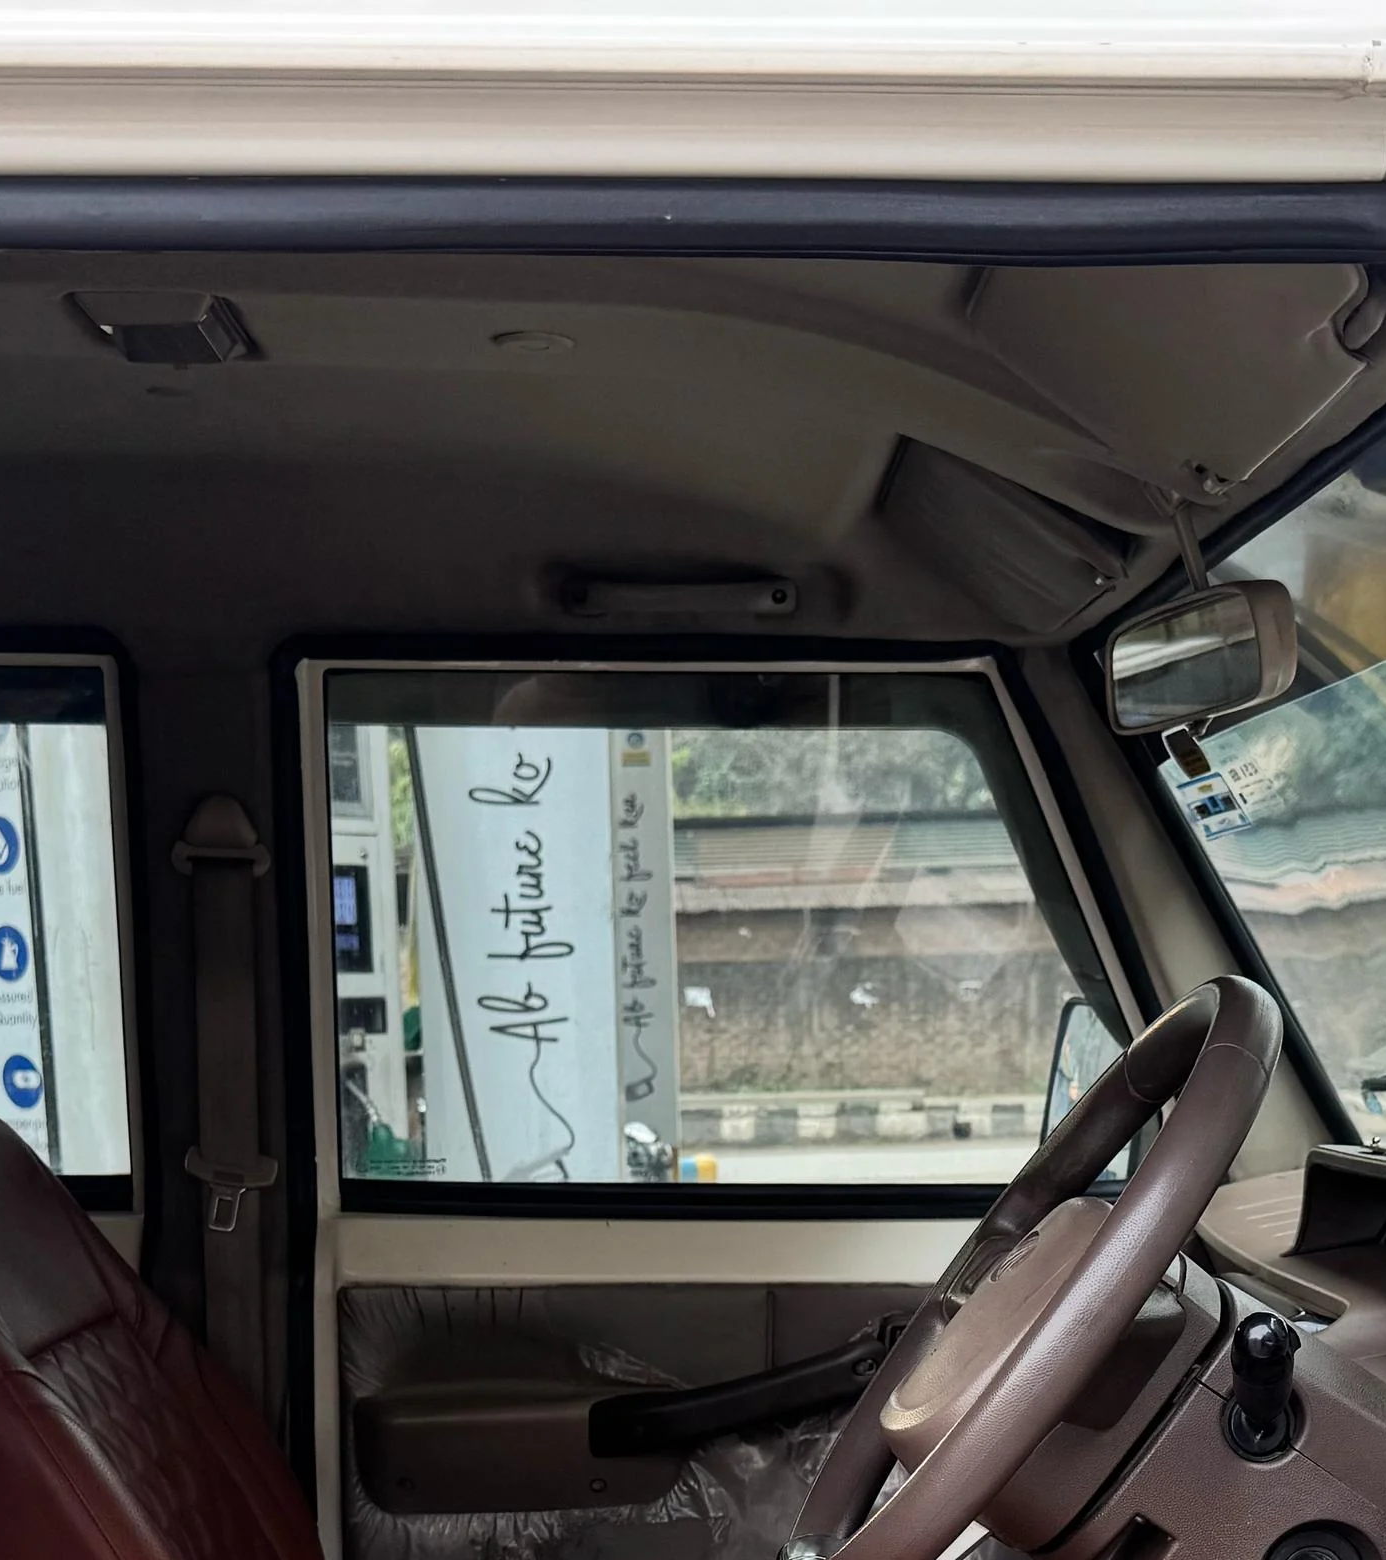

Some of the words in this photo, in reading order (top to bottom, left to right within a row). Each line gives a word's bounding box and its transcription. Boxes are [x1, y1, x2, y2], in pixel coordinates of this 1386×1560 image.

[468, 752, 553, 806] ko
[486, 830, 575, 961] future
[477, 981, 569, 1043] Ab
